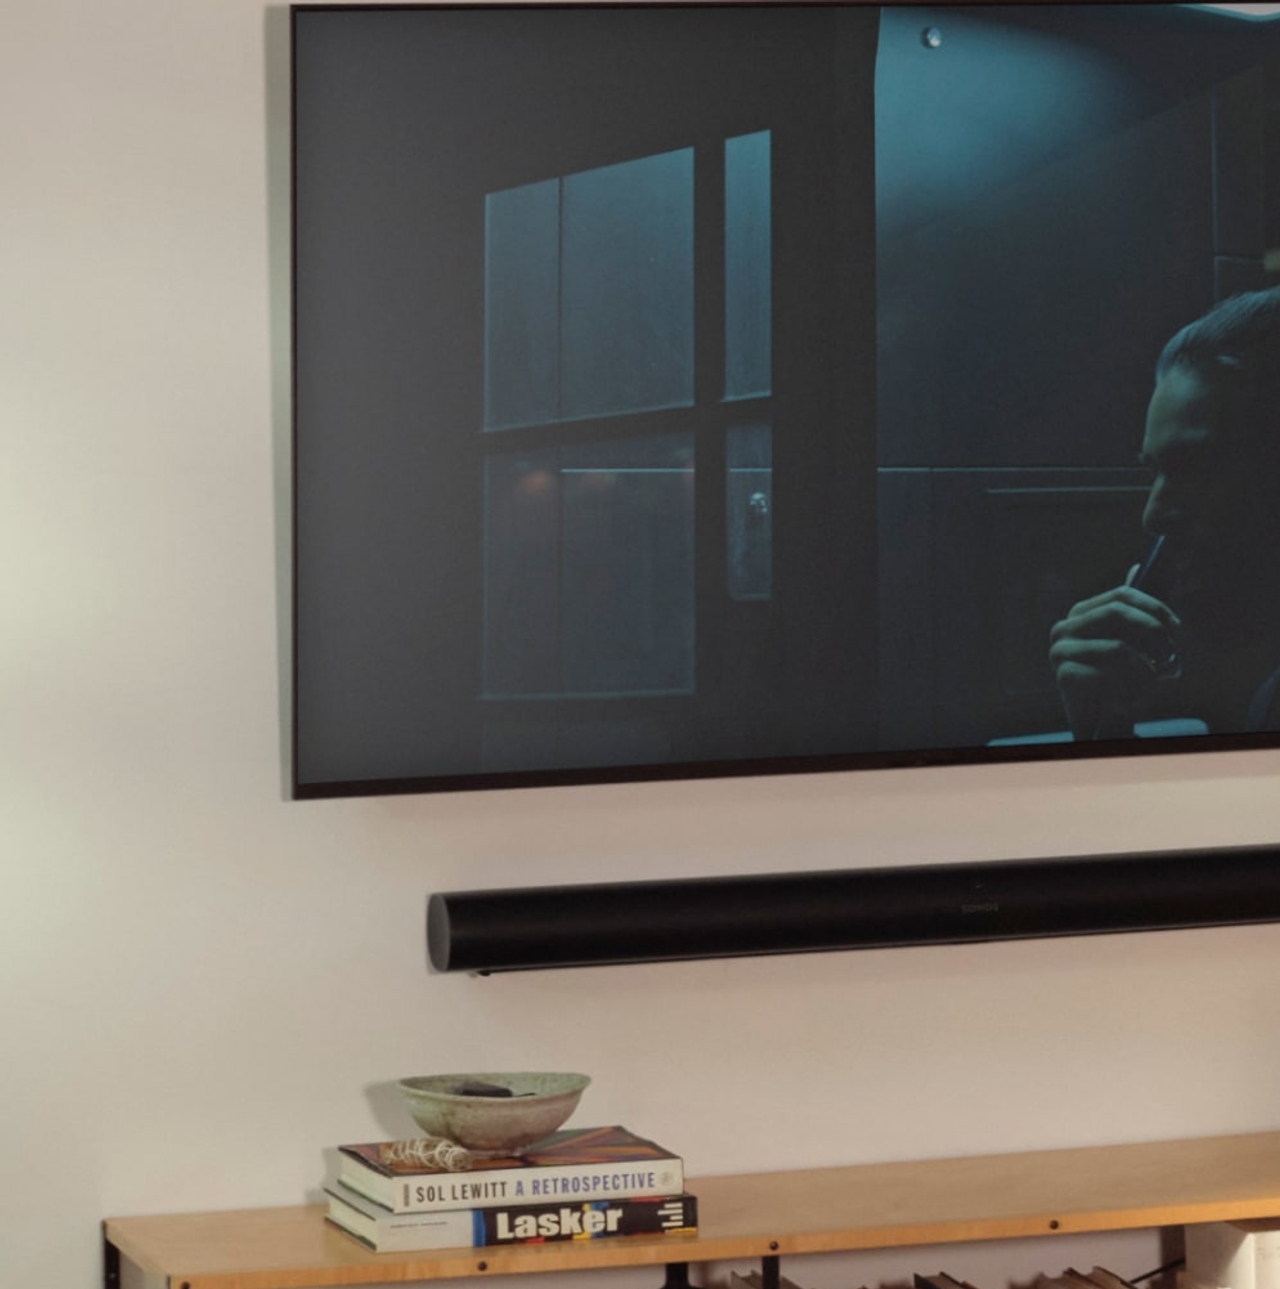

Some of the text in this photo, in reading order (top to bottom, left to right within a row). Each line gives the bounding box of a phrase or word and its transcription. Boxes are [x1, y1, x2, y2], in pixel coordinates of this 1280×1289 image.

[416, 1172, 655, 1203] SOL LEWITT A RETROSPECTIVE
[496, 1208, 623, 1239] Lasker
